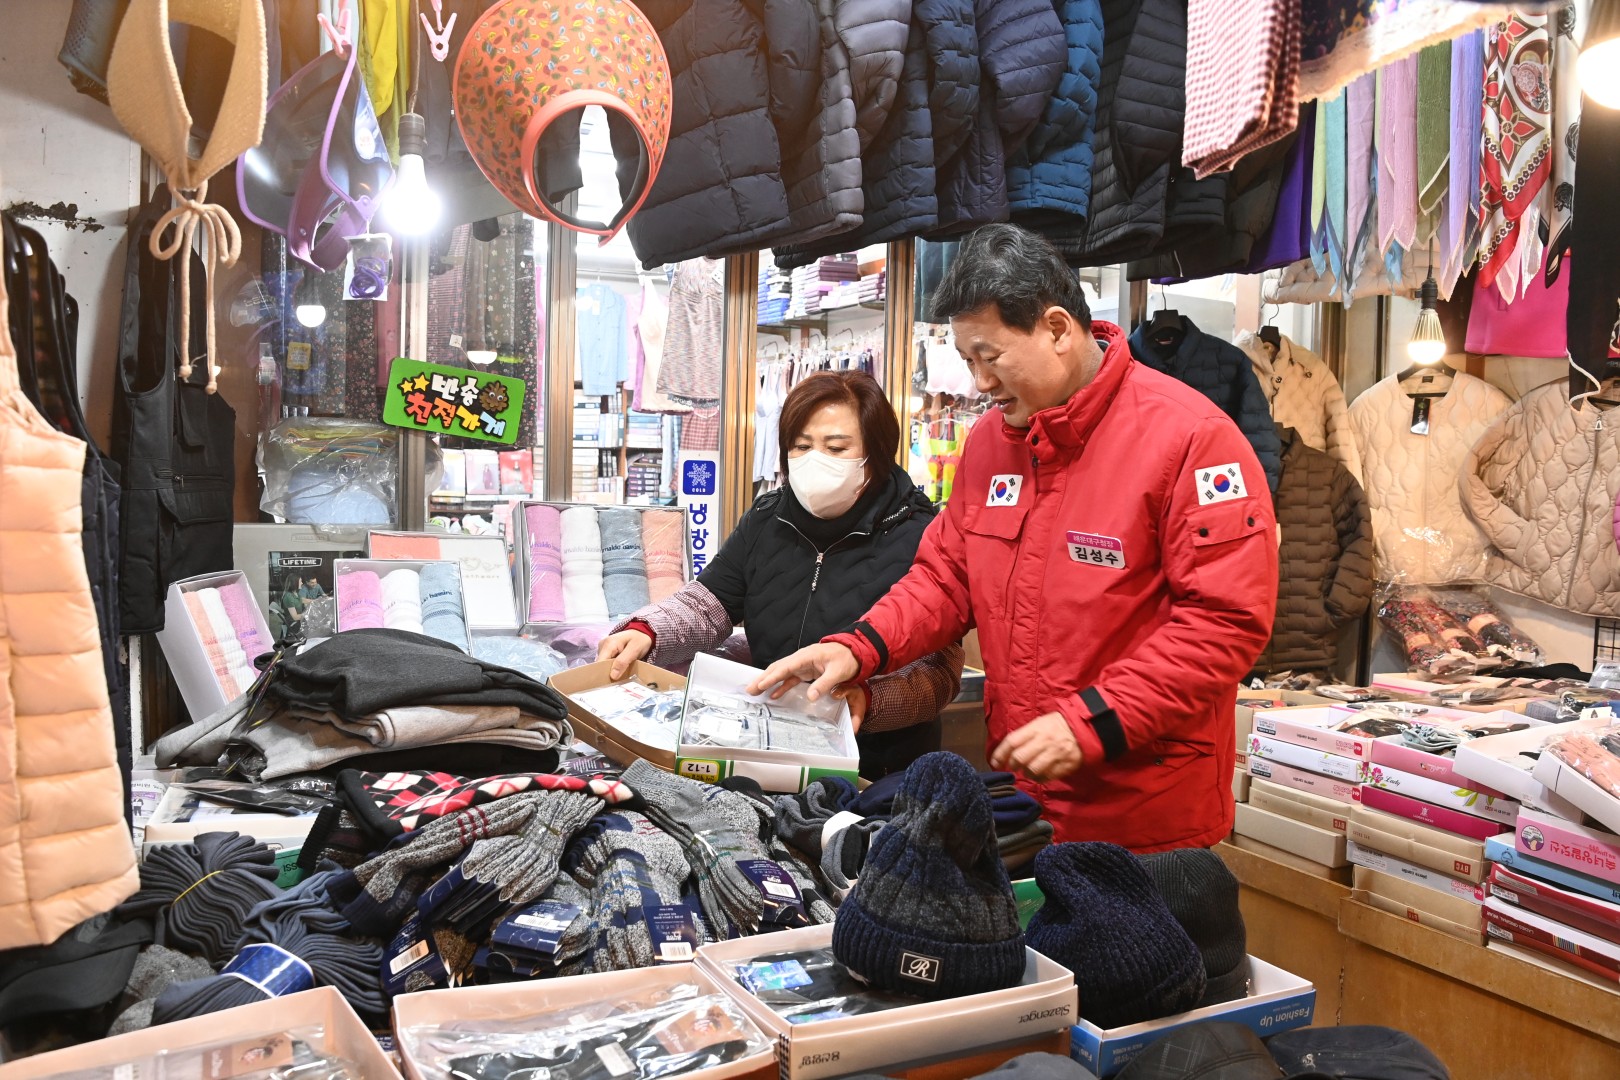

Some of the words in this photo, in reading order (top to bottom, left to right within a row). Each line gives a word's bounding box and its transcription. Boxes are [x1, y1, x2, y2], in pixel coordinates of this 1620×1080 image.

[430, 373, 480, 407] 반송
[405, 391, 507, 437] 친절가게
[1073, 535, 1114, 549] 해운대구청장
[1075, 546, 1119, 565] 김성수
[1261, 744, 1274, 754] Lady
[687, 763, 710, 773] 1-12
[1385, 775, 1401, 787] Lady
[1334, 819, 1345, 830] BYC
[1550, 841, 1616, 871] 숙녀양말덧신
[282, 861, 298, 875] ssi
[1401, 867, 1415, 876] cardin
[1455, 862, 1469, 873] BYC
[1415, 872, 1428, 880] pierre
[1259, 1013, 1274, 1028] Up
[1274, 1005, 1311, 1023] Fashion
